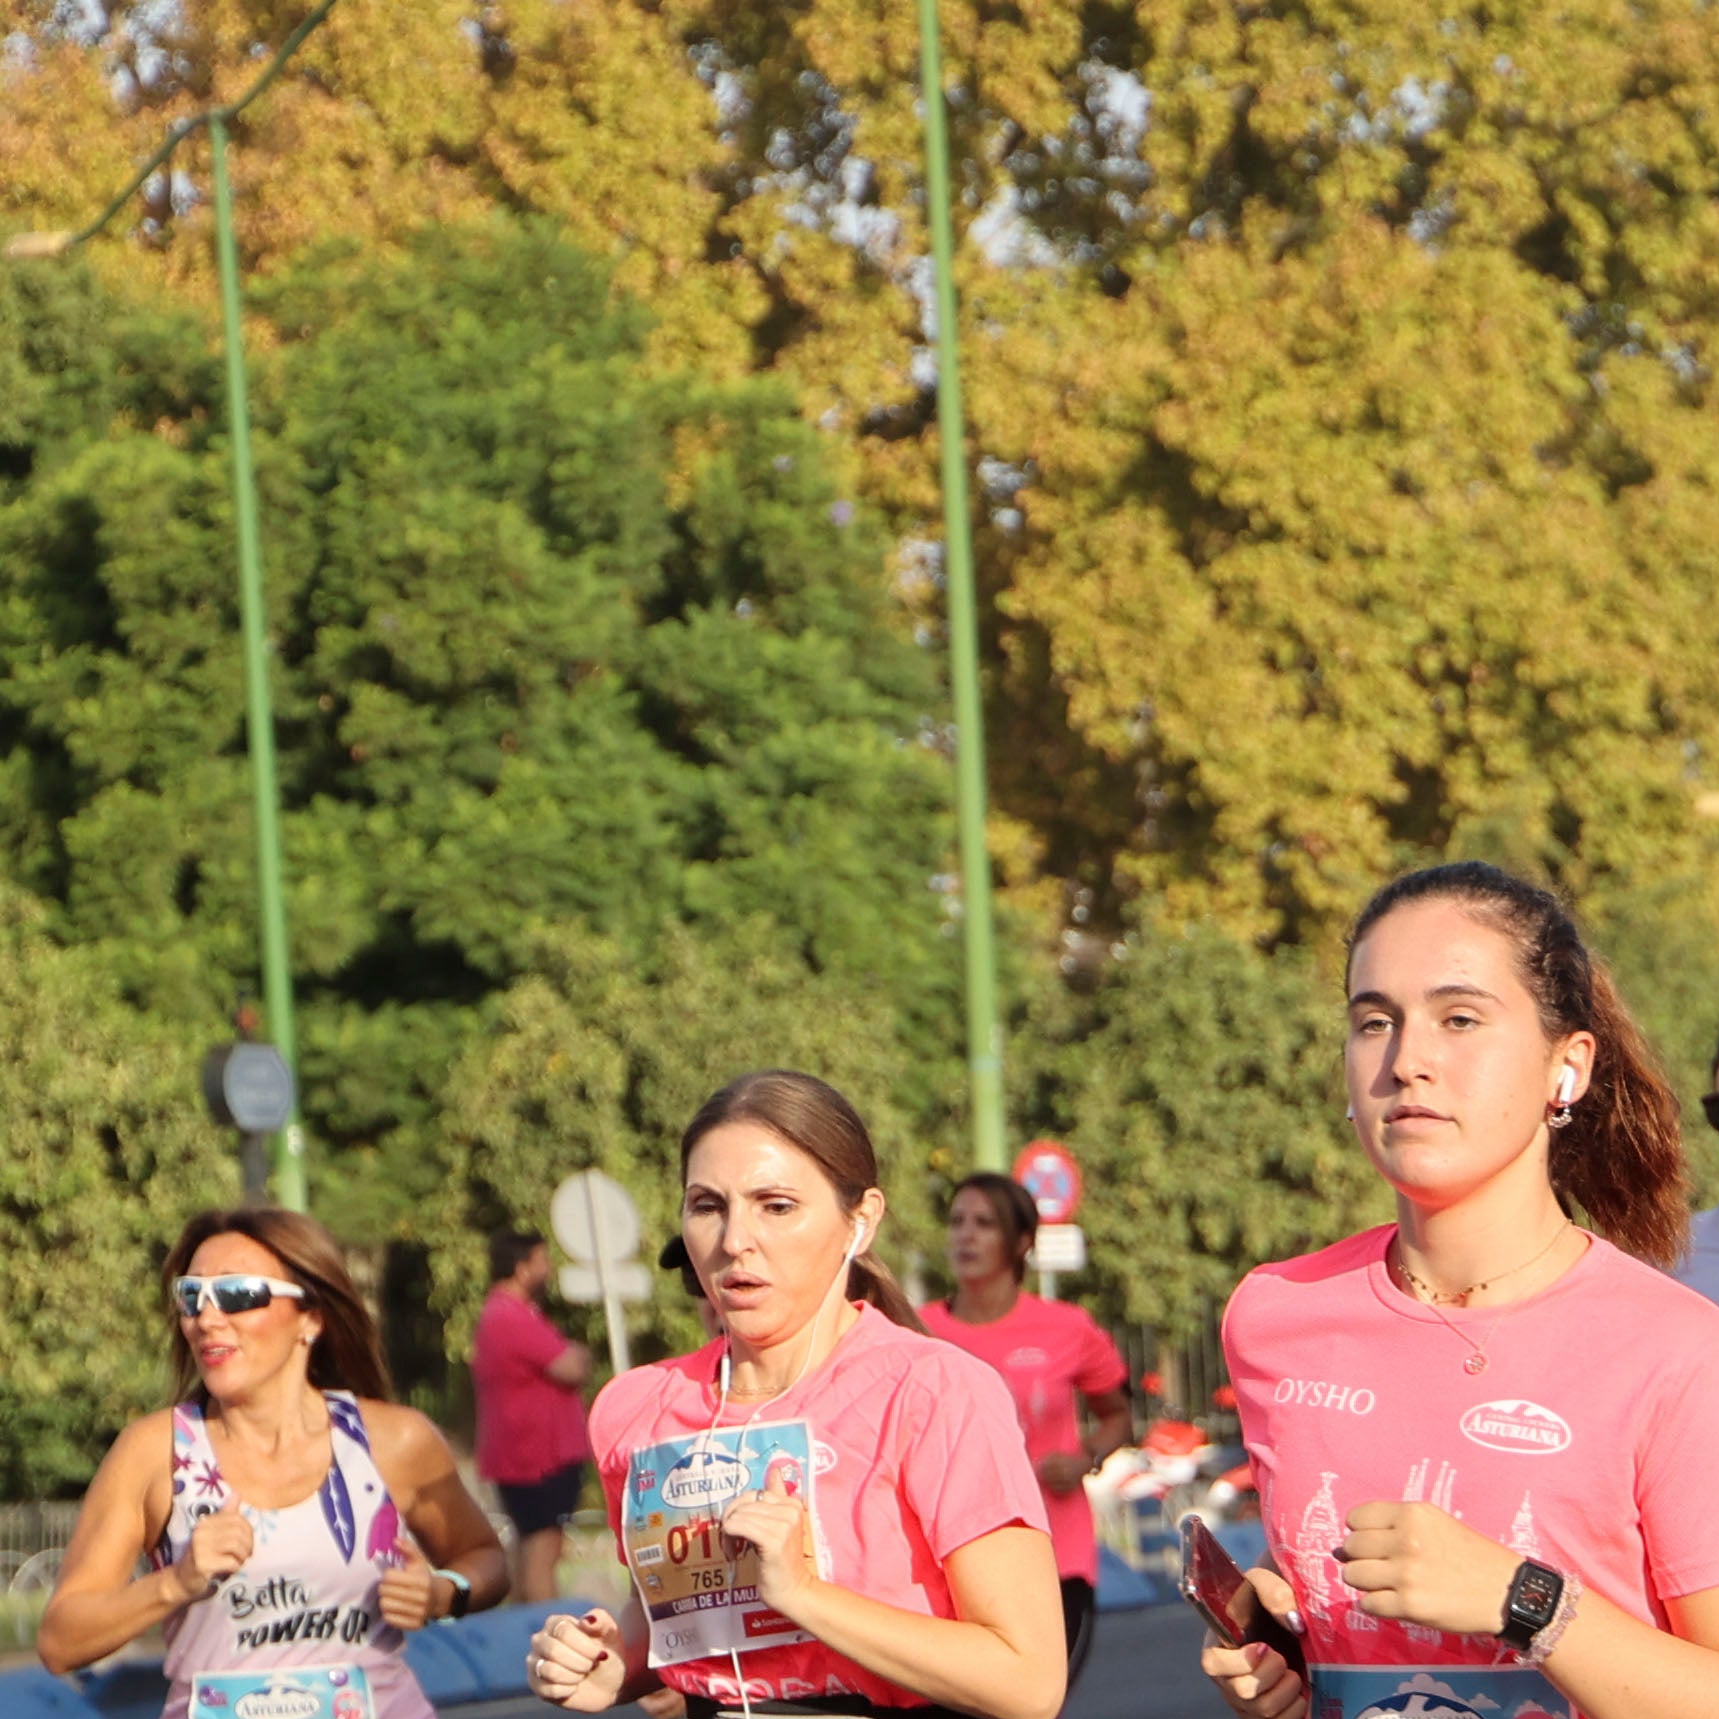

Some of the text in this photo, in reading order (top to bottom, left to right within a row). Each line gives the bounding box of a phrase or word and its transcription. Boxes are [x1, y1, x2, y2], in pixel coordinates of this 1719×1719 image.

[1274, 1378, 1376, 1416] OYSHO
[1465, 1412, 1562, 1447] ASTURIANA
[690, 1568, 724, 1591] 765
[699, 1594, 714, 1608] DE
[733, 1587, 760, 1603] MUJ
[236, 1608, 339, 1649] POWER
